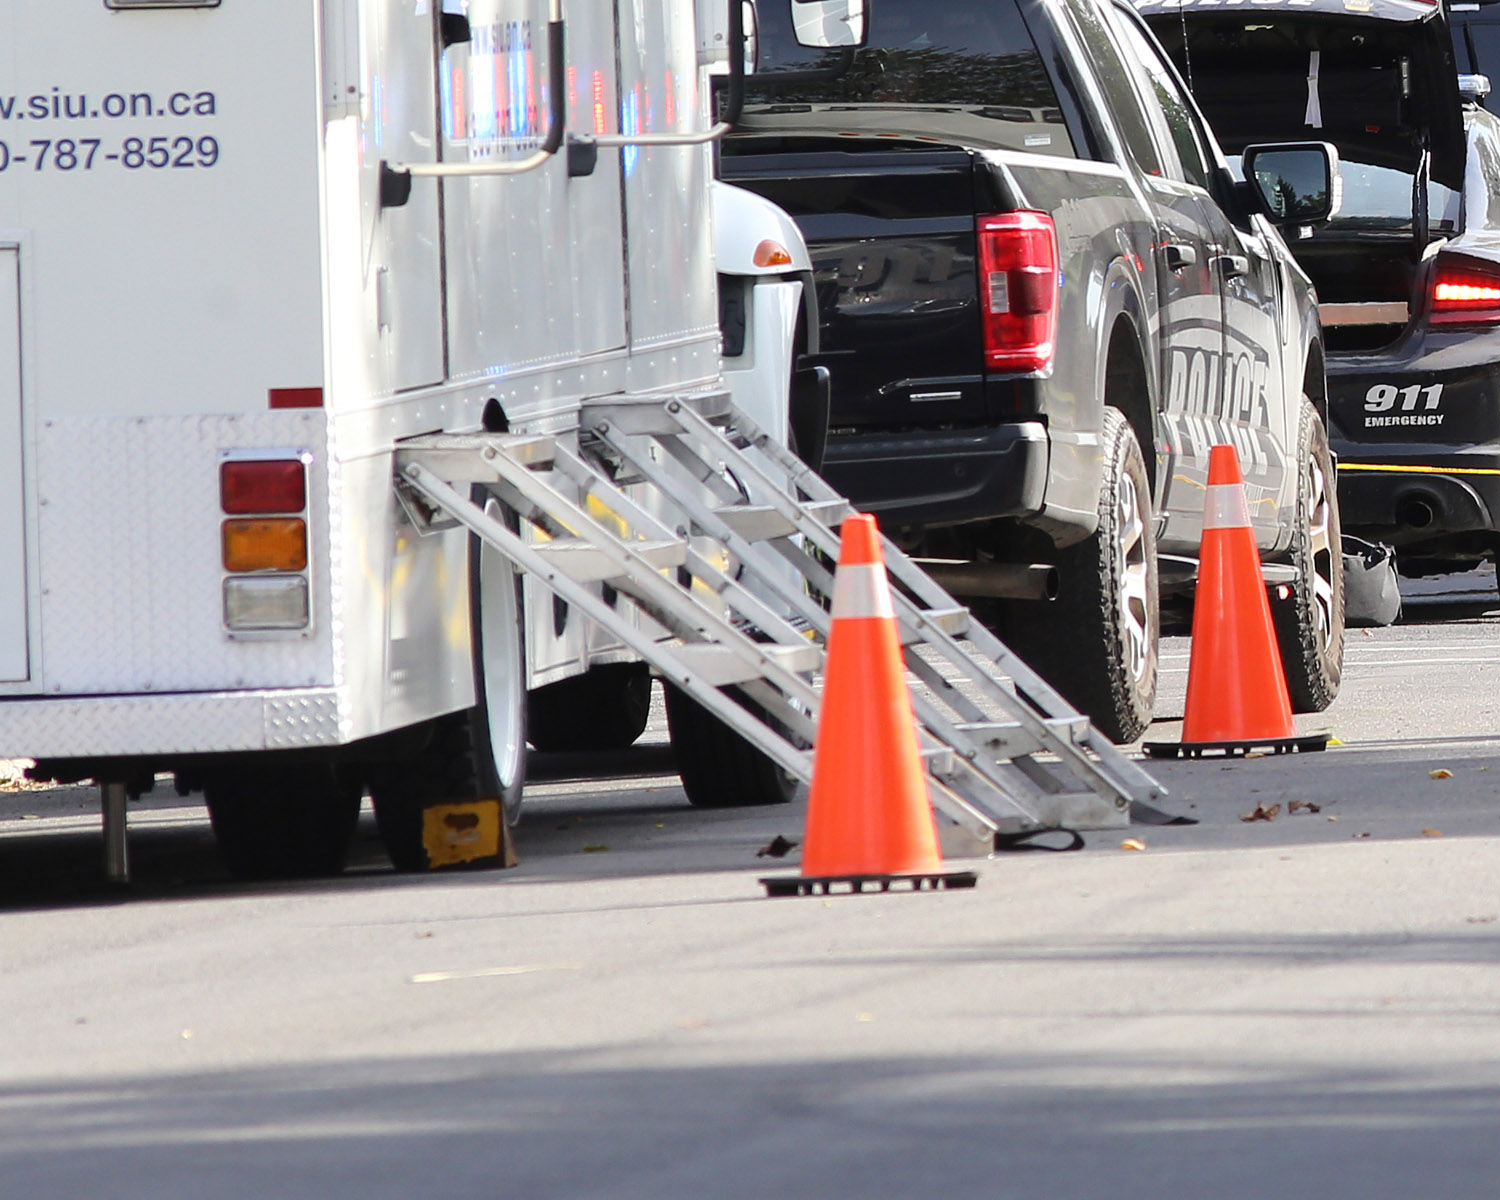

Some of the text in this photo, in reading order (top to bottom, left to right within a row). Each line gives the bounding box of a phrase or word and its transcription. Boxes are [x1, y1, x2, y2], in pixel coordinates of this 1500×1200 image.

[1364, 384, 1443, 411] 911
[1167, 350, 1268, 475] POLICE
[1365, 414, 1444, 428] EMERGENCY
